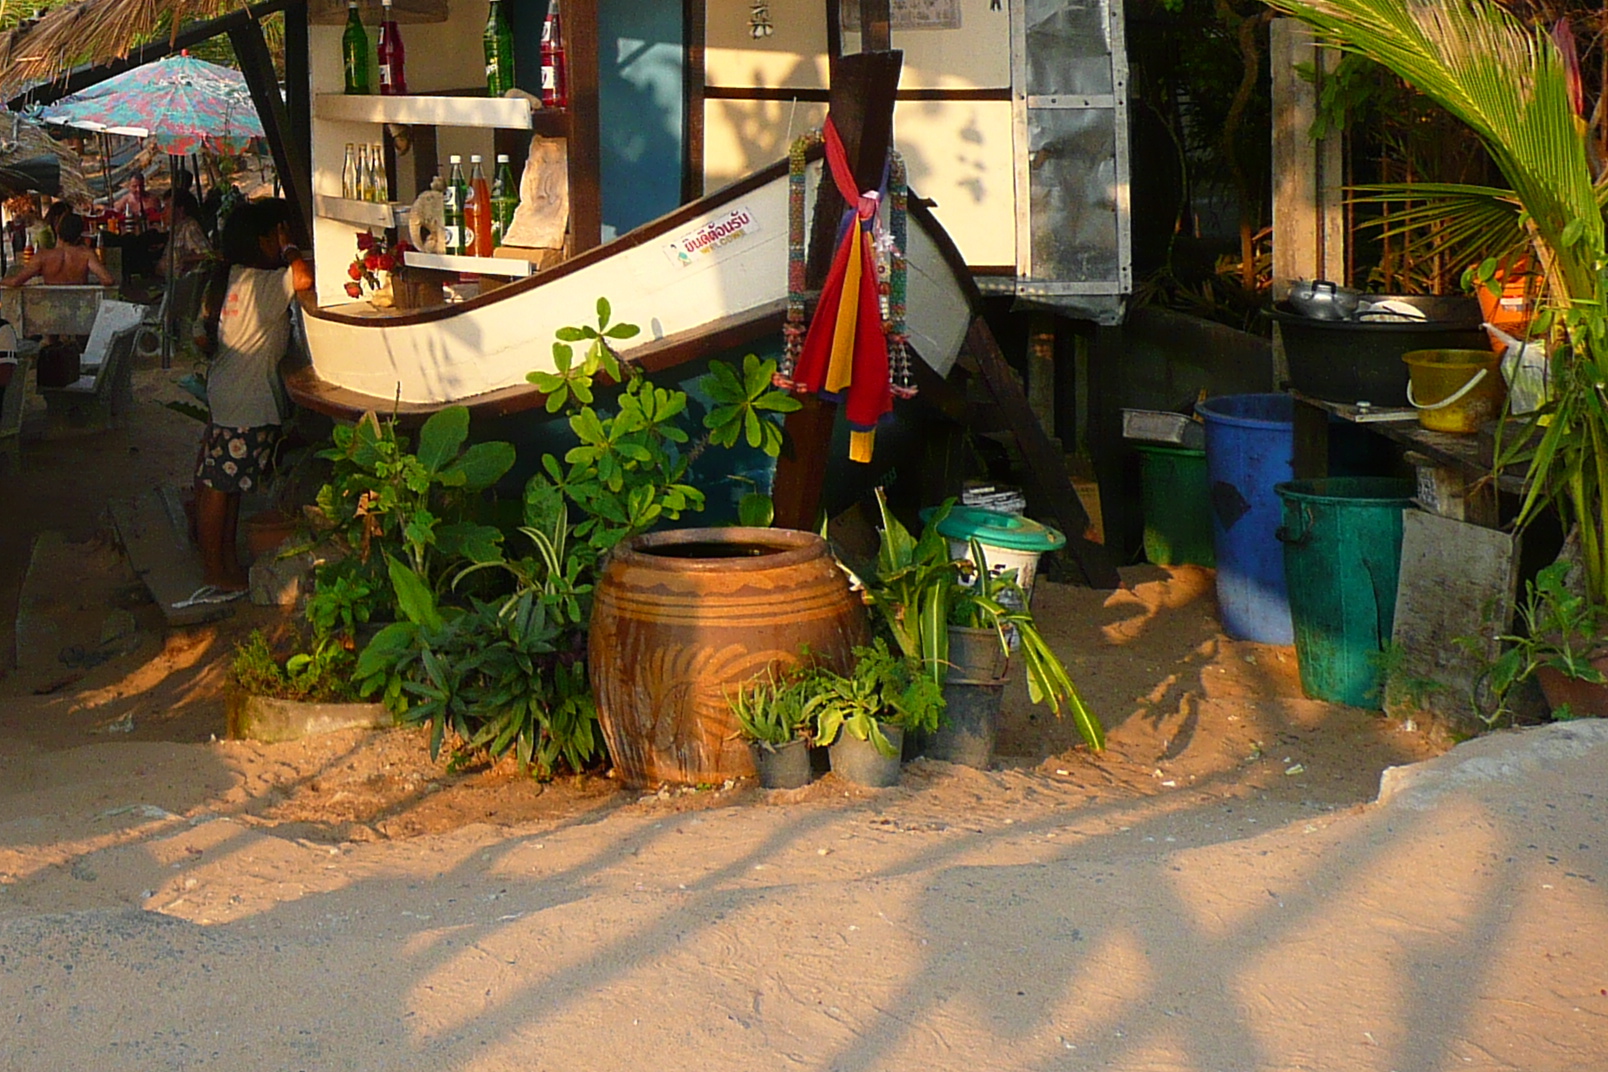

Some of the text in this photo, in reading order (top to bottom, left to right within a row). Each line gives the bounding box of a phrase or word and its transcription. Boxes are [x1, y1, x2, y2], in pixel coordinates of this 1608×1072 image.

[682, 210, 750, 253] ยินดีต้อนรับ
